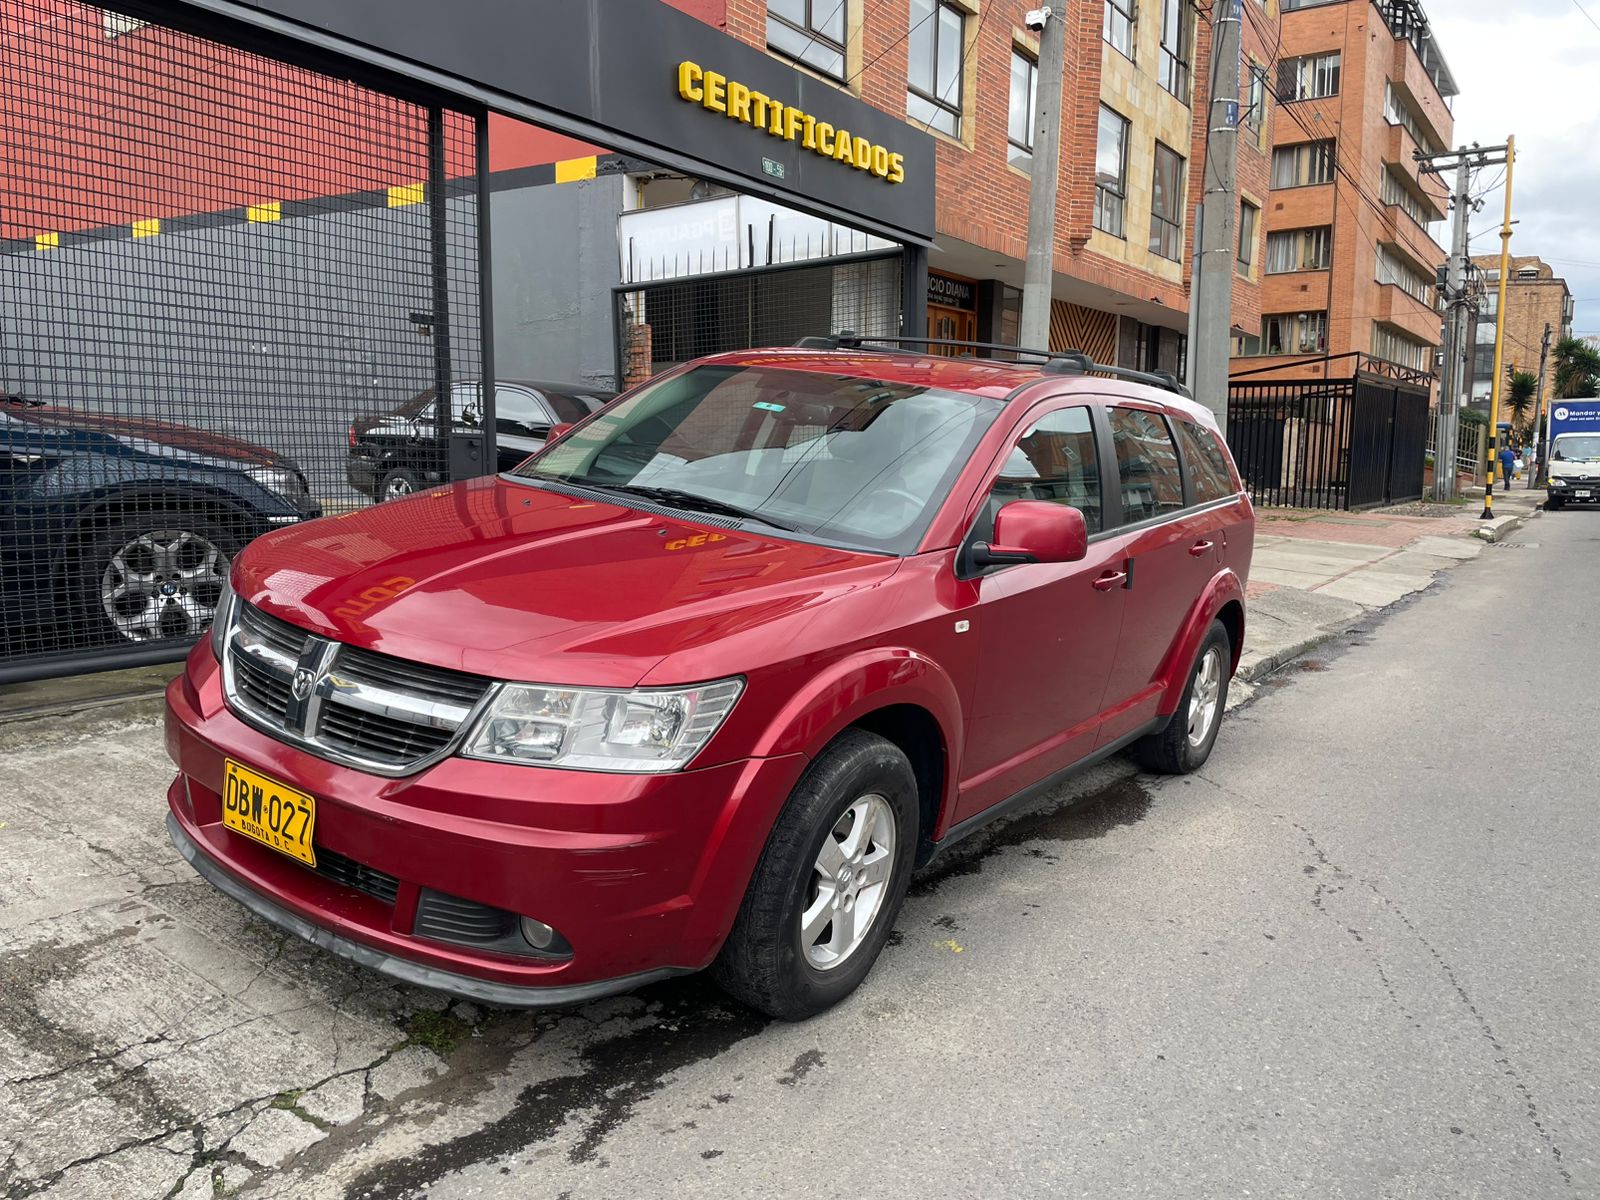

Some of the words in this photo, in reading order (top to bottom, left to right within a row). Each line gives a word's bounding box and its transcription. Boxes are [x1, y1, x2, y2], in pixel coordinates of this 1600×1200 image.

[678, 60, 905, 184] CERTIFICADOS
[946, 281, 970, 300] DIANA
[241, 819, 270, 841] BOGOTA
